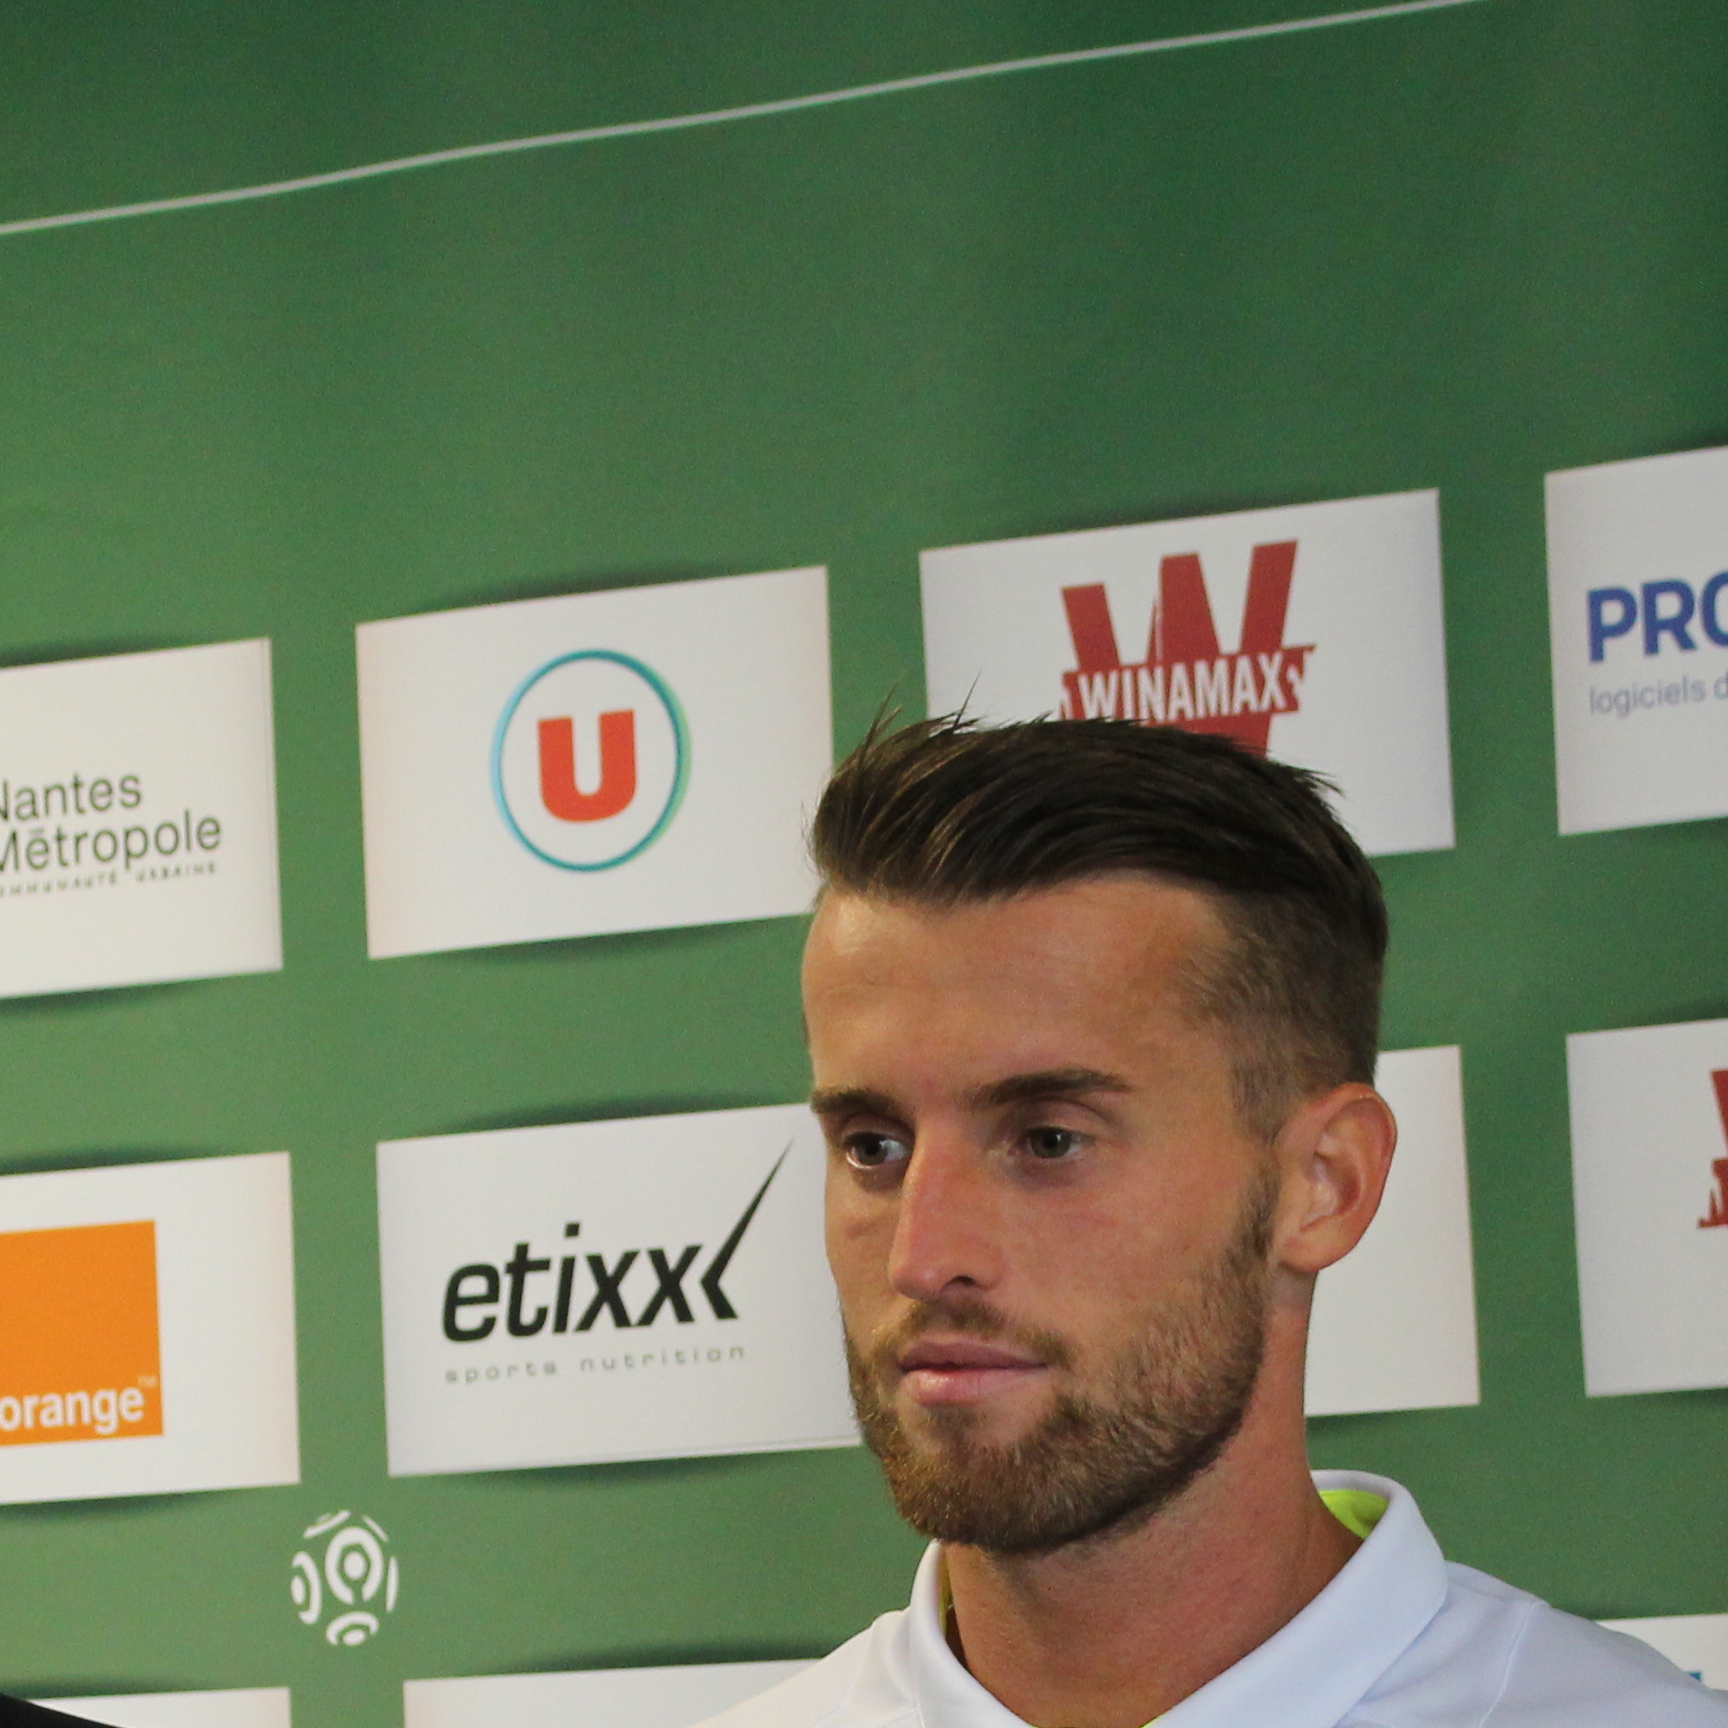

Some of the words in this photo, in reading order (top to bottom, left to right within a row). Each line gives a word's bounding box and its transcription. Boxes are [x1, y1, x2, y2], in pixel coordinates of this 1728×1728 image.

[1077, 650, 1286, 721] WINAMAX
[1589, 676, 1707, 717] logiciels
[536, 709, 636, 823] U
[445, 1361, 558, 1385] sports
[580, 1346, 746, 1372] nutrition
